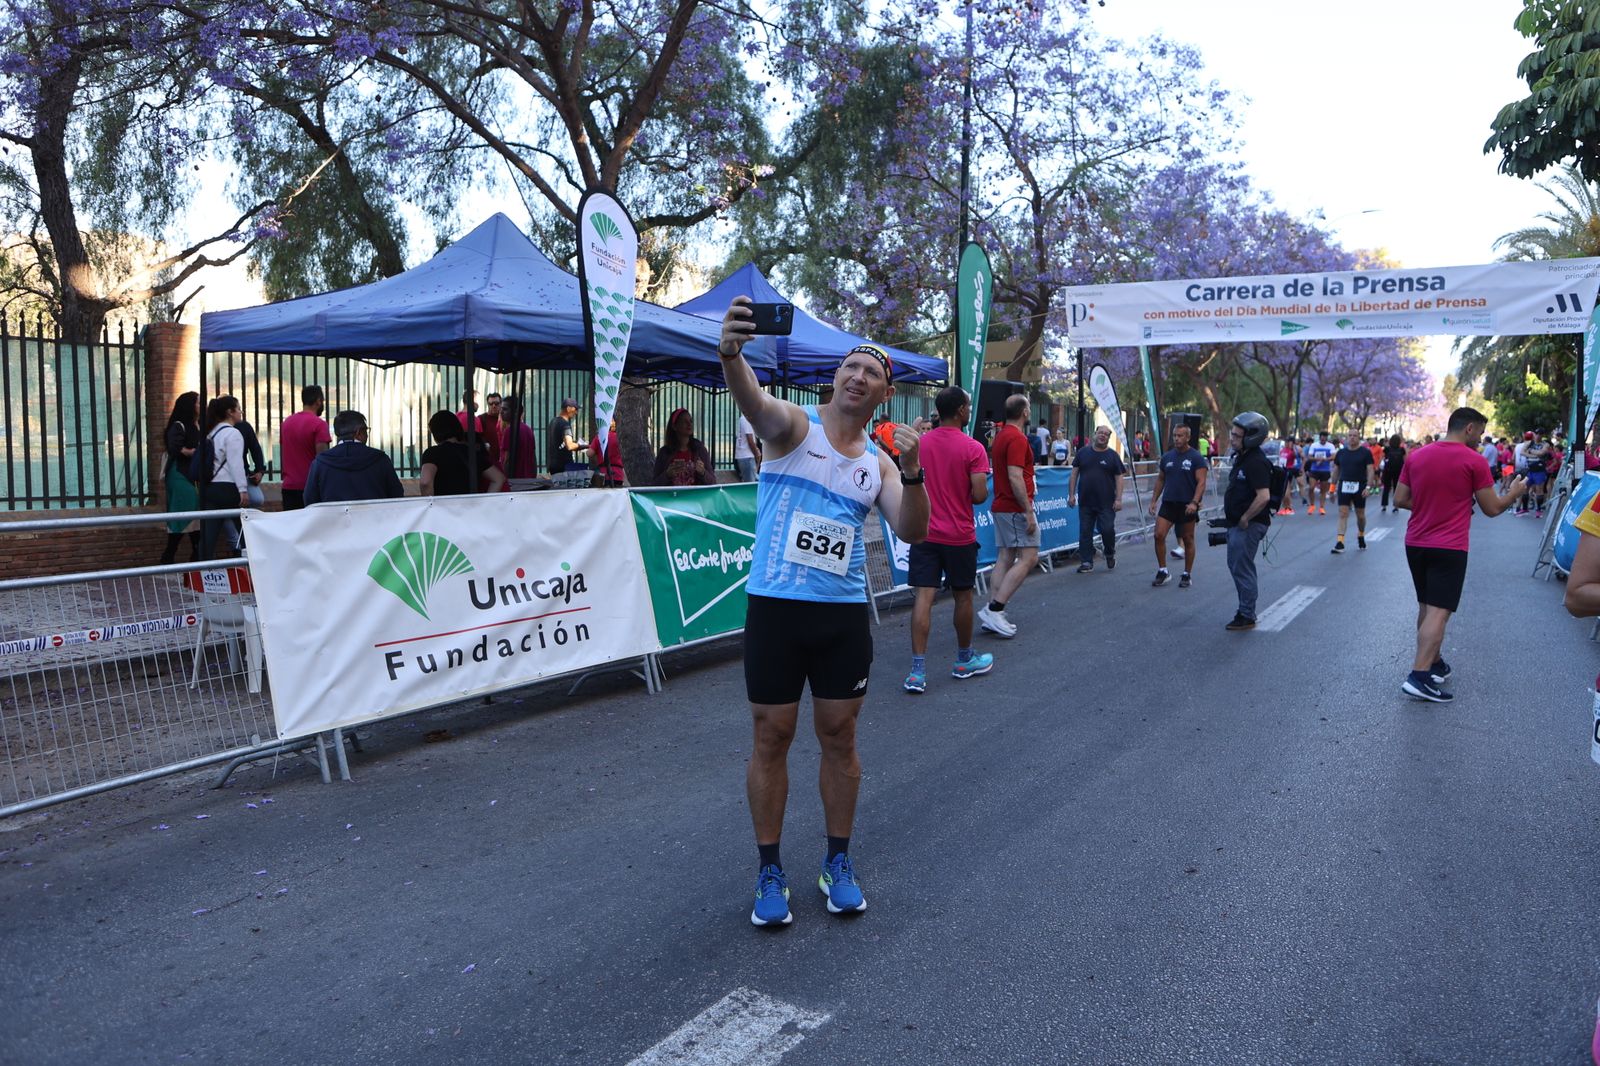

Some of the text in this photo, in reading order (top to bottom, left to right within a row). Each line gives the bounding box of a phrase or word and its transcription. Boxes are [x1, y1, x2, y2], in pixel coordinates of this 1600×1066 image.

[591, 242, 626, 266] Fundación
[597, 257, 623, 276] Unicaja
[1185, 274, 1446, 302] Carrera de la Prensa
[1144, 296, 1487, 320] con motivo del Día Mundial de la Libertad de Prensa
[765, 487, 791, 583] MELILLERO
[796, 530, 847, 561] 634
[673, 547, 691, 572] El
[689, 547, 721, 569] Corte
[719, 539, 756, 574] Inglé
[468, 561, 588, 610] Unicaja
[0, 640, 31, 655] POLICI
[384, 619, 591, 681] Fundación
